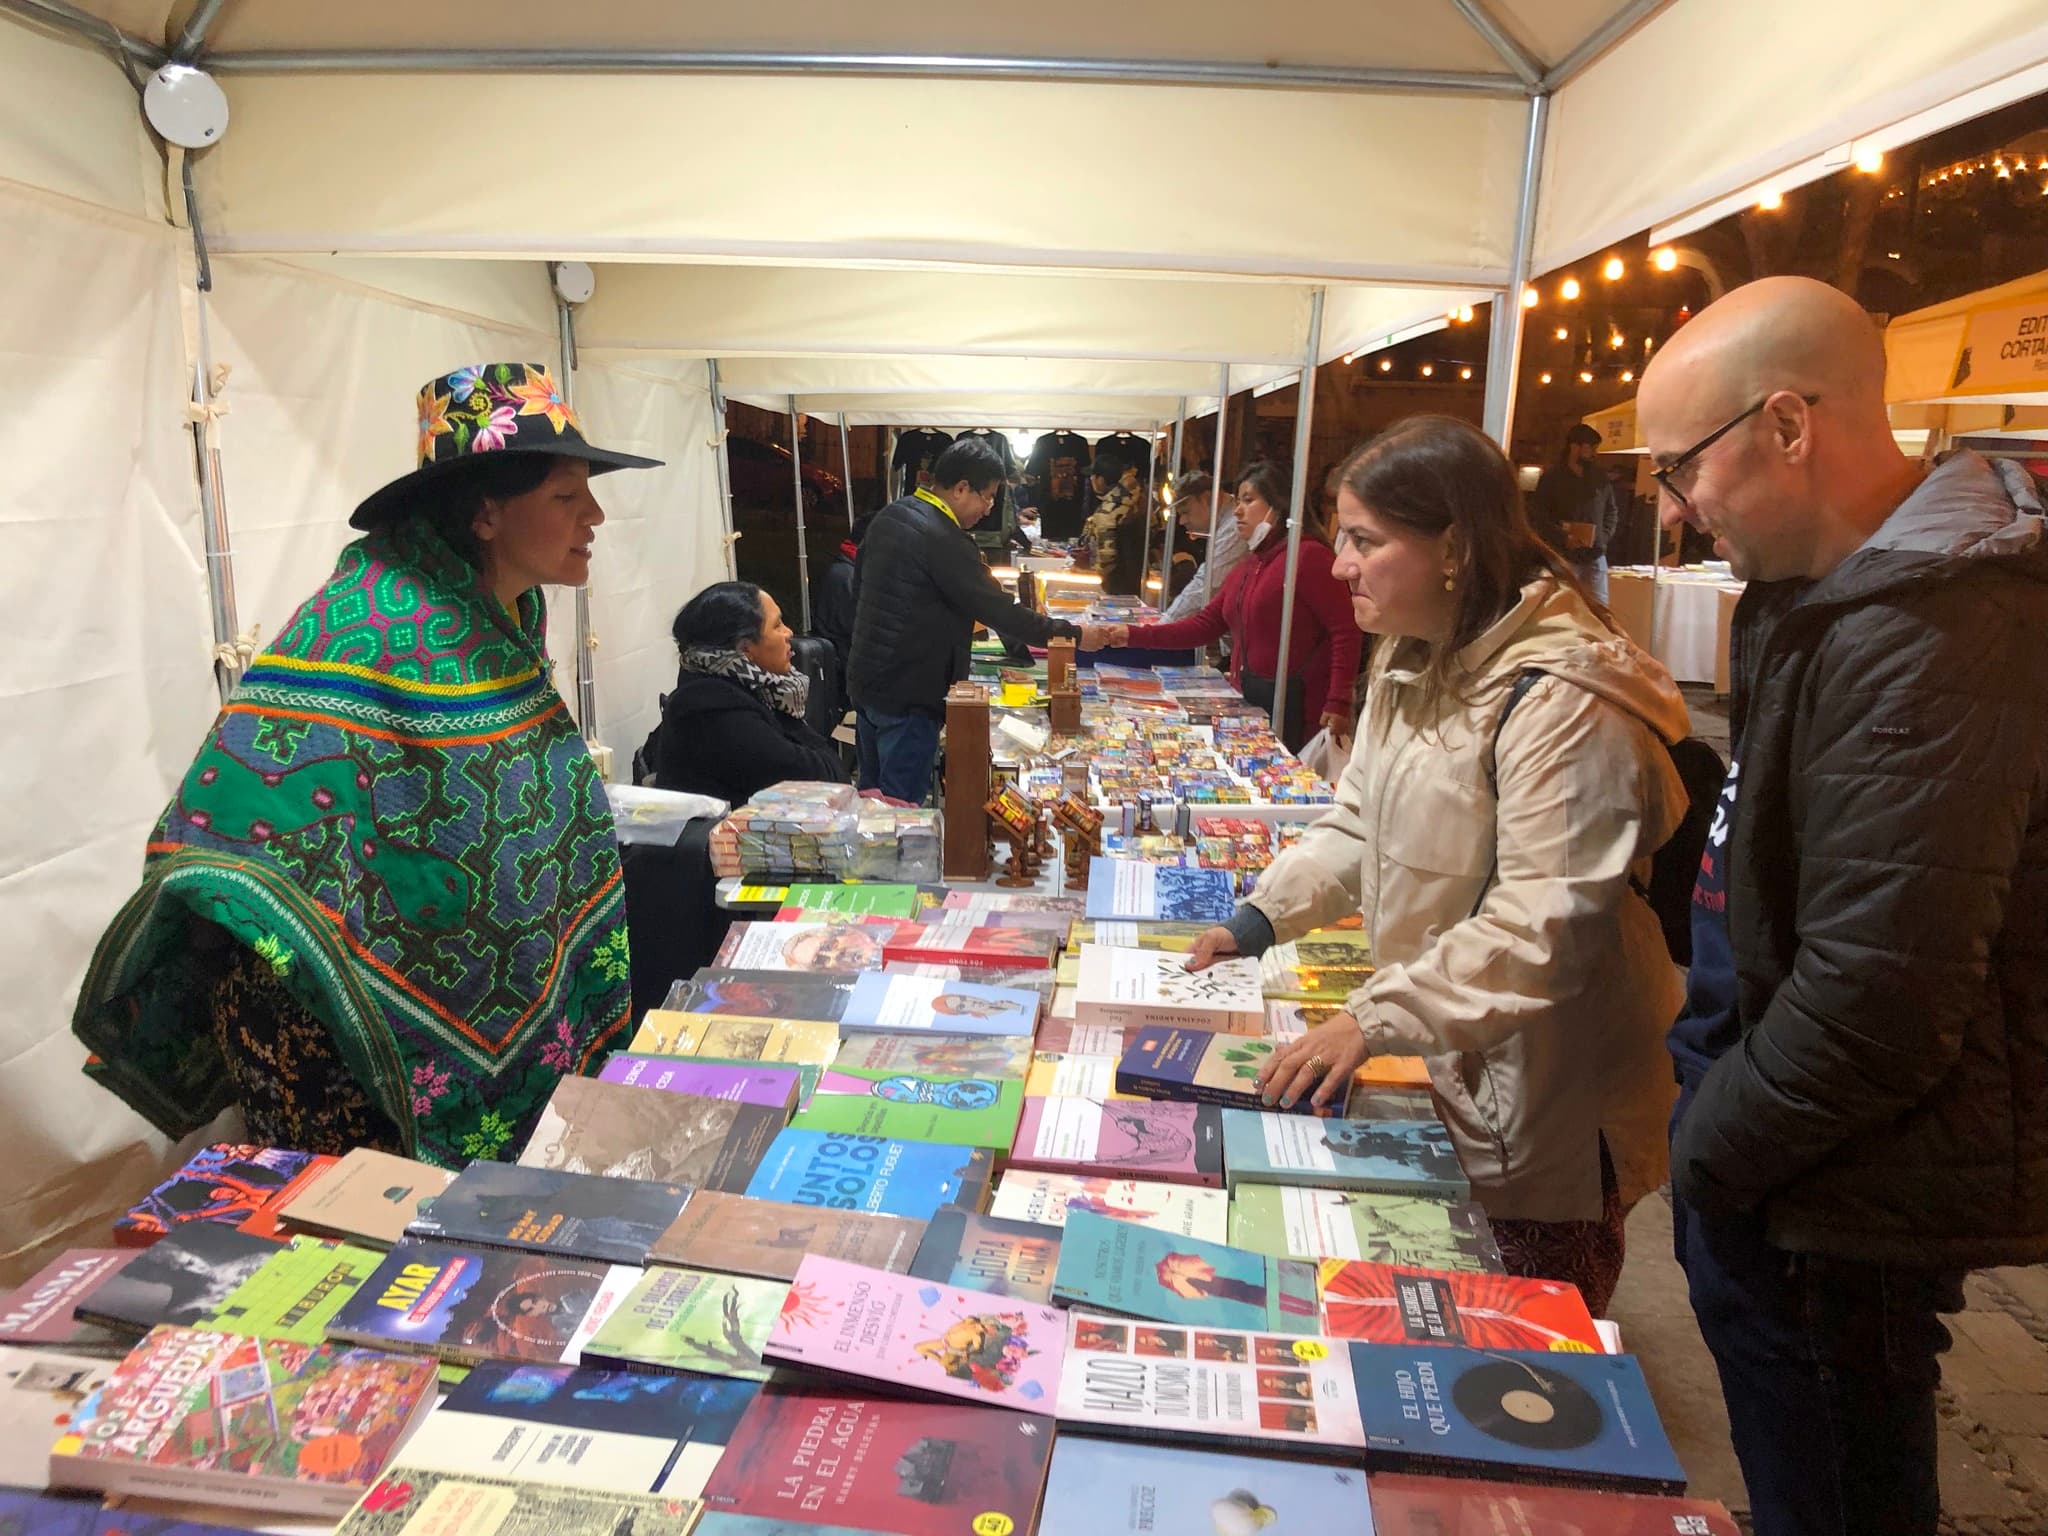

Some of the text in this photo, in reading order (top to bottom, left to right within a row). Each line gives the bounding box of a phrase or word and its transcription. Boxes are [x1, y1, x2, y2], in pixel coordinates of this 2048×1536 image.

[376, 1263, 442, 1313] AYAR
[839, 1280, 872, 1339] INMENSO
[1408, 1316, 1426, 1329] LA
[1425, 1312, 1442, 1325] LA
[1428, 1324, 1446, 1337] DE
[833, 1338, 852, 1355] EL
[112, 1331, 225, 1454] ARGUEDAS
[1395, 1369, 1421, 1420] EL HIJO
[1413, 1360, 1451, 1436] QUE PERDÍ
[776, 1405, 837, 1500] LA PIEDRA
[800, 1402, 865, 1512] EN EL AGUA
